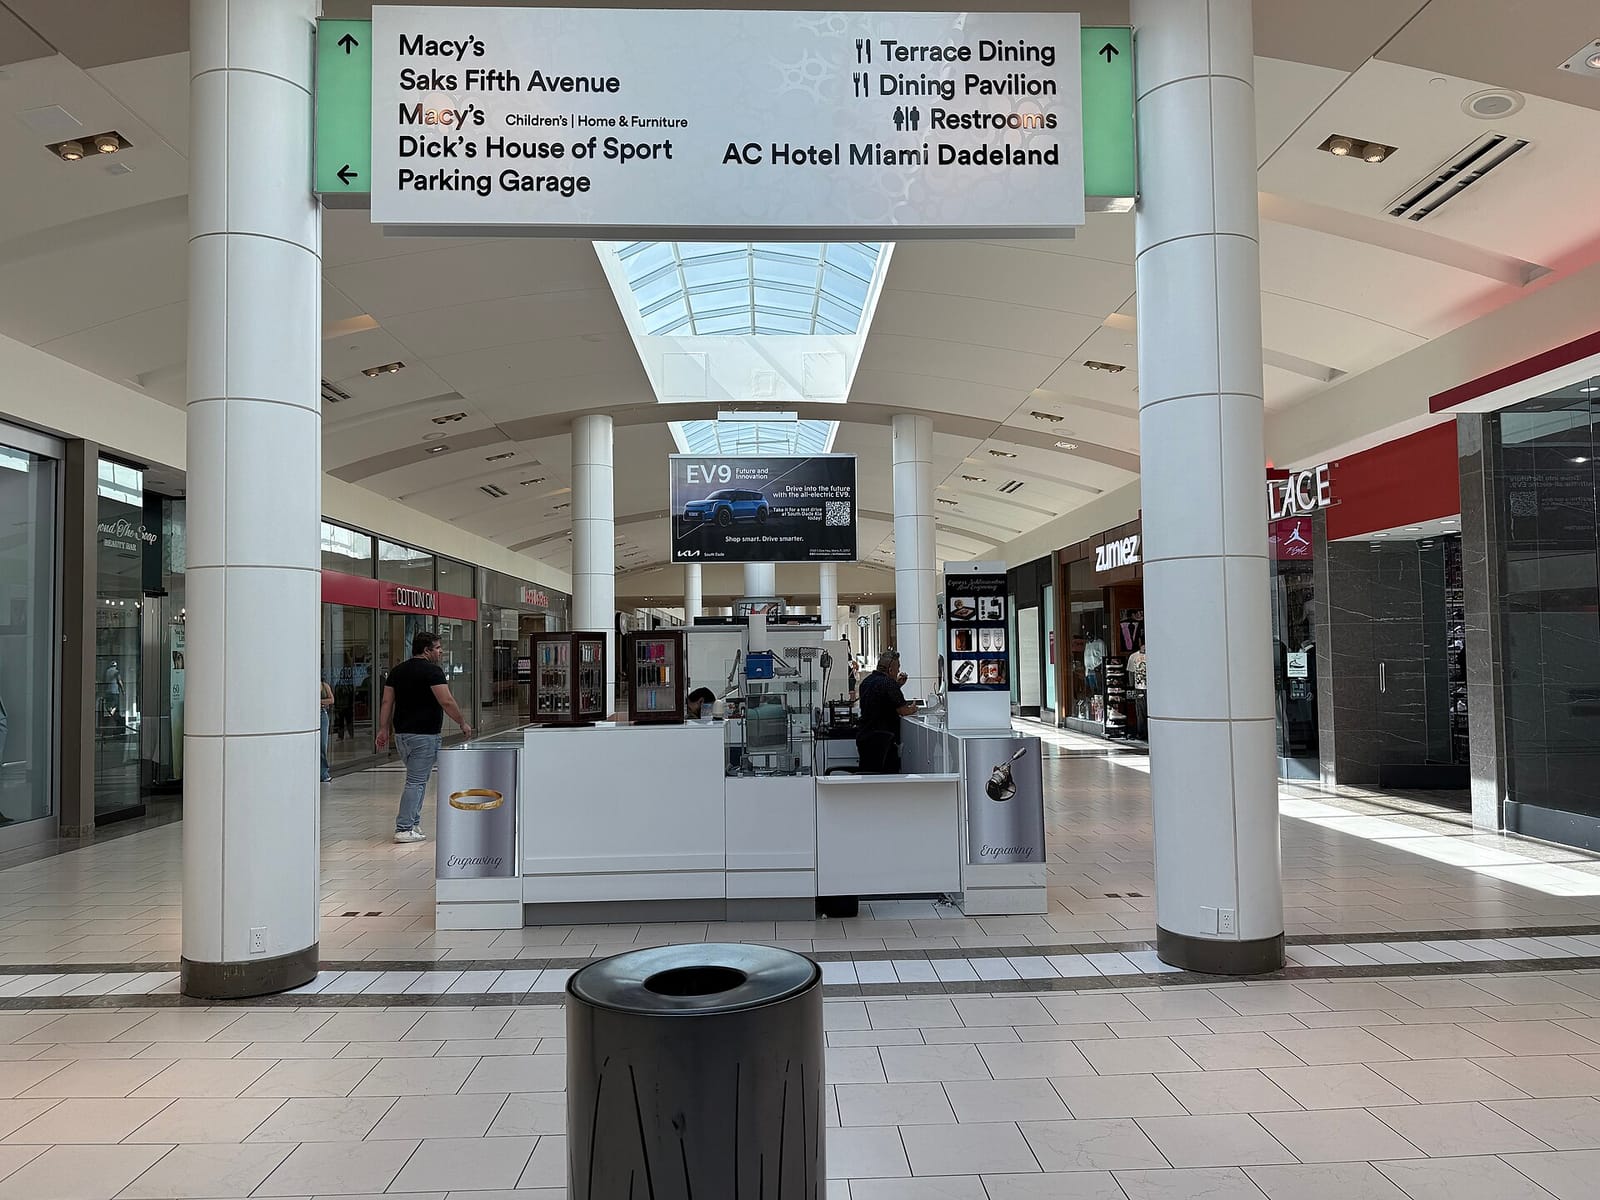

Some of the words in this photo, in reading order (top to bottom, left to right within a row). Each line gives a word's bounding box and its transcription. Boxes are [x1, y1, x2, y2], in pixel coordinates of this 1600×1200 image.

[399, 34, 485, 61] Macy's
[880, 40, 971, 62] Terrace
[978, 40, 1056, 67] Dining
[399, 69, 458, 92] Saks
[465, 69, 520, 92] Fifth
[527, 71, 620, 93] Avenue
[879, 74, 955, 101] Dining
[964, 74, 1057, 96] Pavilion
[399, 103, 485, 130] Macy's
[505, 114, 568, 127] Children's
[578, 115, 616, 127] Home
[618, 116, 629, 127] &
[631, 115, 688, 128] Furniture
[930, 108, 1057, 130] Restrooms
[399, 135, 477, 158] Dick's
[486, 137, 565, 159] House
[572, 137, 597, 159] of
[603, 137, 673, 164] Sport
[722, 143, 762, 165] AC
[771, 143, 840, 165] Hotel
[850, 143, 929, 165] Miami
[938, 143, 1059, 166] Dadeland
[398, 168, 492, 197] Parking
[499, 169, 591, 198] Garage
[686, 465, 732, 484] EV9
[1268, 463, 1331, 519] LACE
[1095, 534, 1139, 572] zumiez
[396, 587, 424, 608] COTTON
[425, 592, 436, 610] ON
[447, 854, 503, 870] Engraving
[980, 844, 1034, 860] Engraving
